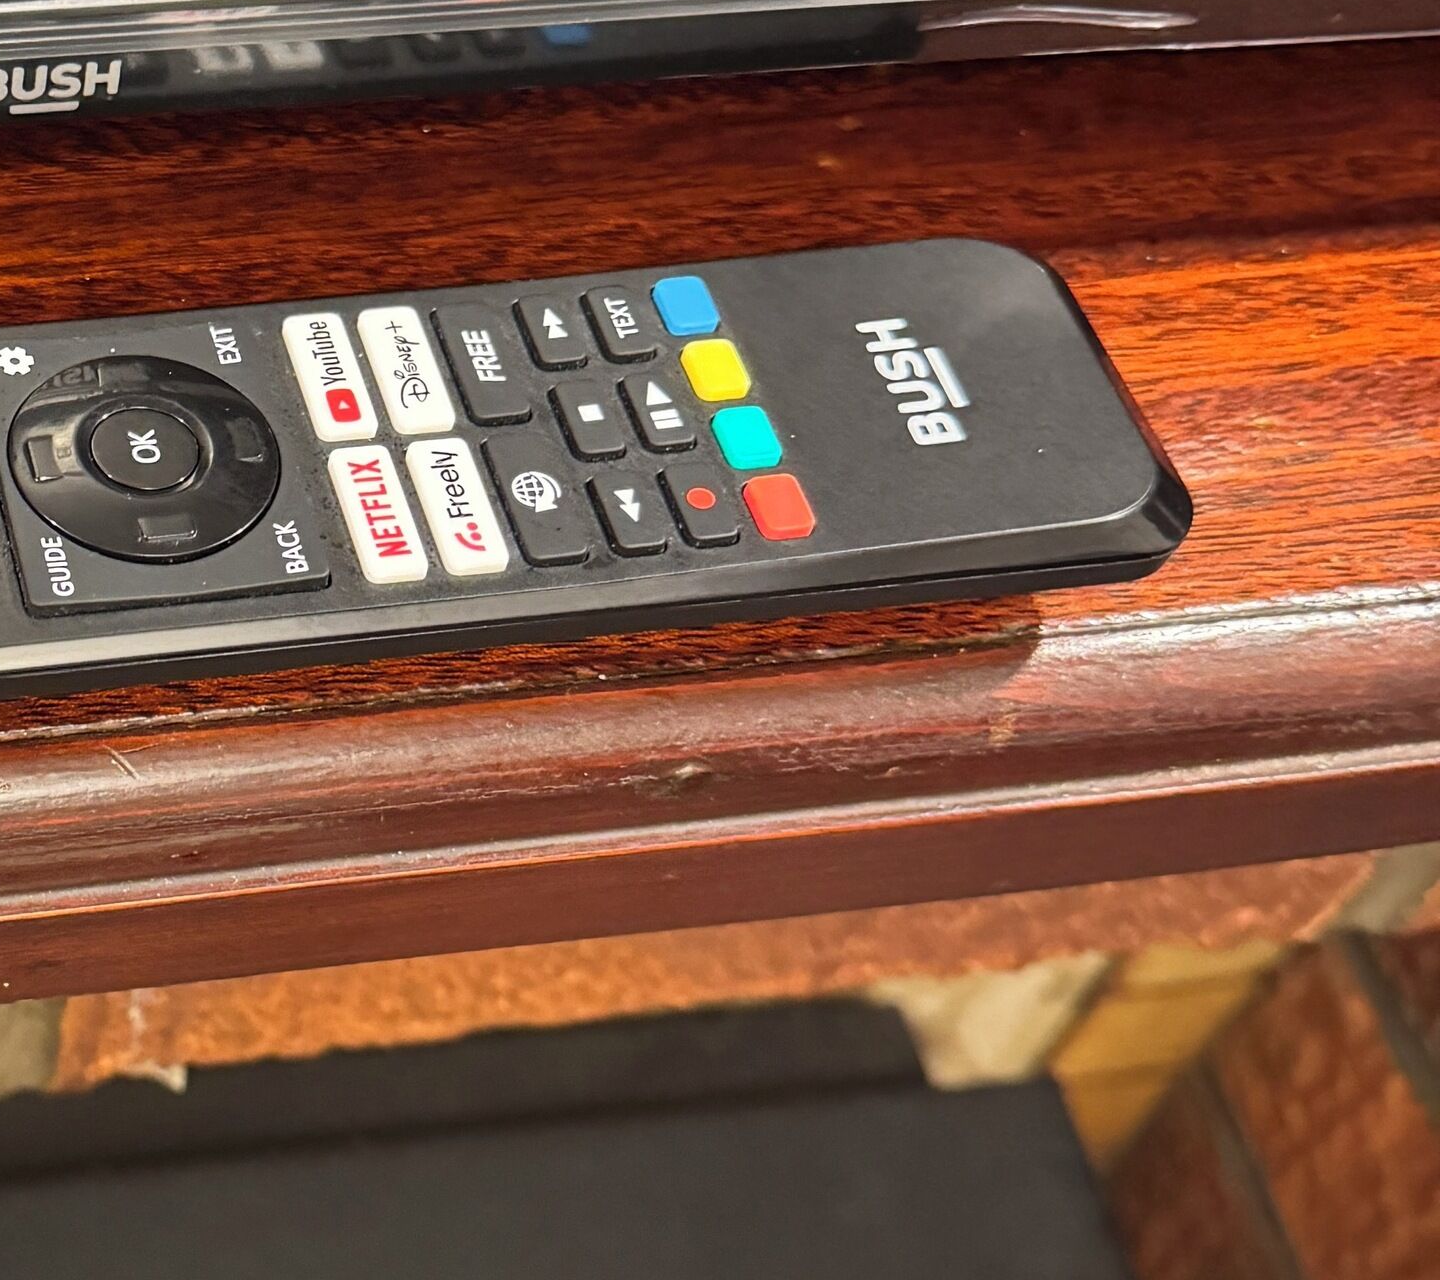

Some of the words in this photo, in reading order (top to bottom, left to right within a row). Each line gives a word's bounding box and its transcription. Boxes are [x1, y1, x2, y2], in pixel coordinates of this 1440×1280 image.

[209, 325, 242, 365] EXIT
[603, 297, 639, 339] TEXT
[306, 320, 347, 386] YouTube
[384, 320, 430, 409] Disney+
[460, 329, 507, 382] FREE
[855, 318, 970, 446] BUSH
[127, 428, 161, 464] OK
[348, 459, 411, 558] NETFLIX
[430, 450, 474, 519] Freely
[40, 535, 75, 597] GUIDE
[272, 520, 310, 574] BACK
